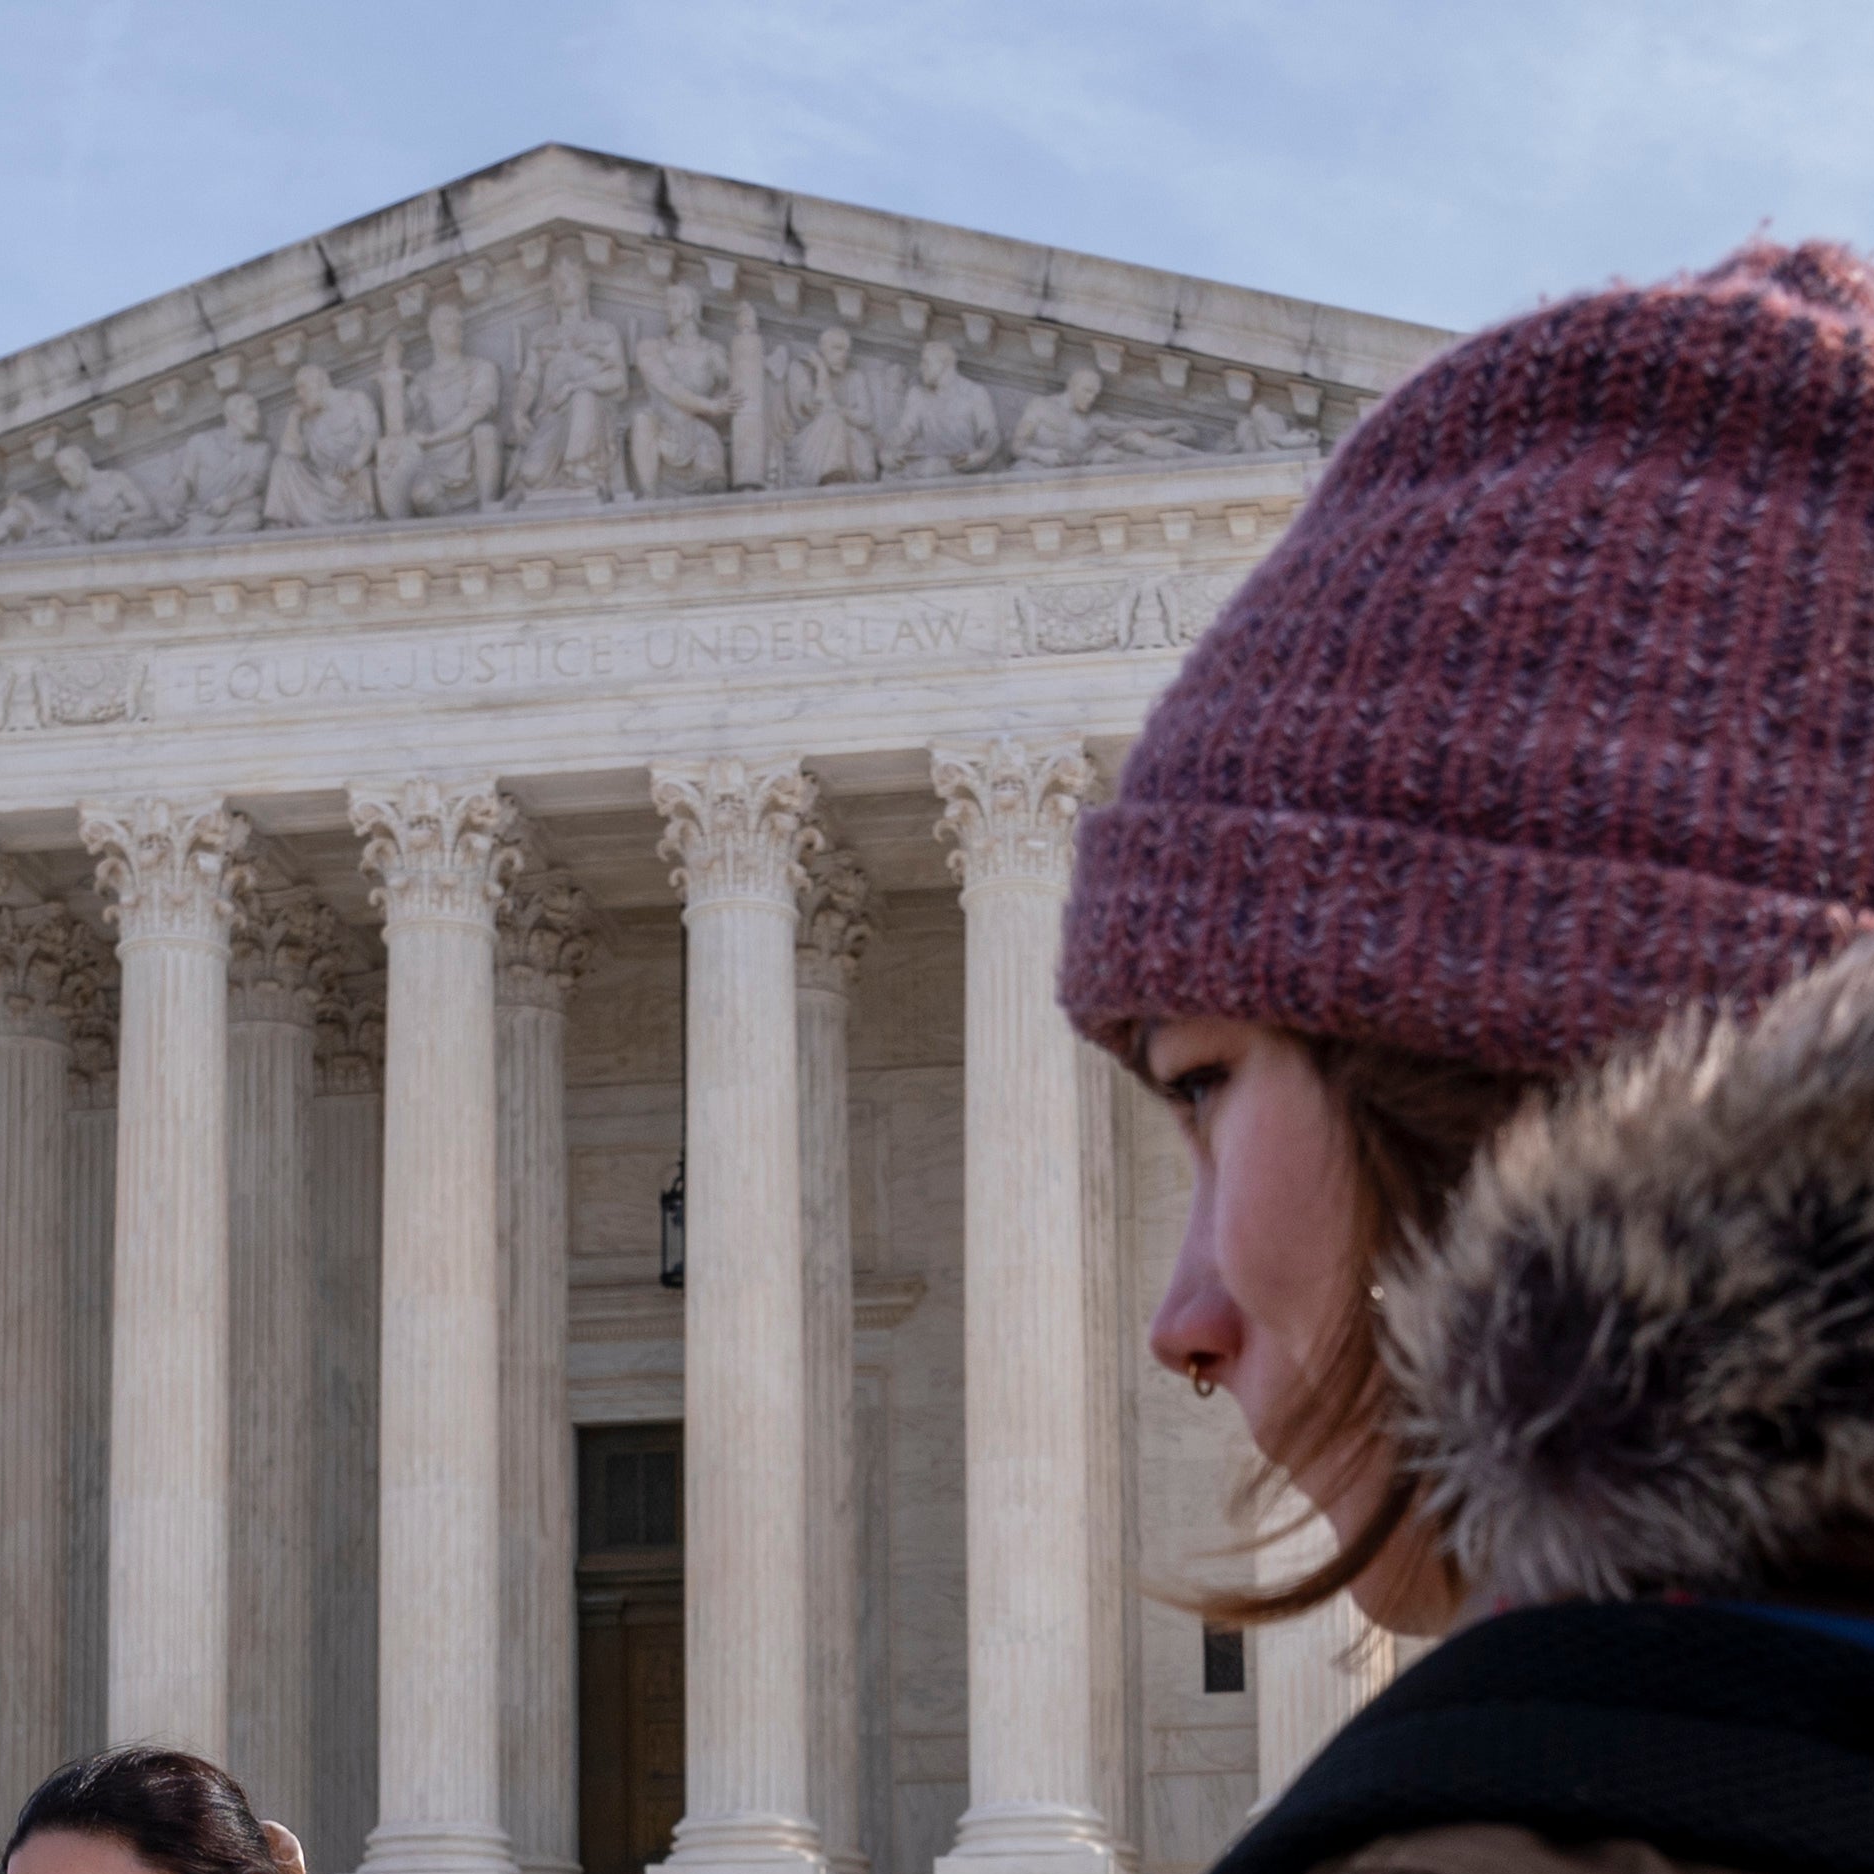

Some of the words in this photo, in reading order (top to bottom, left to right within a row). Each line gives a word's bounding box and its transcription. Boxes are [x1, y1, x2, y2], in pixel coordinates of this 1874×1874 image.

[193, 654, 381, 702] EQUAL
[393, 634, 614, 692] JUSTICE
[643, 618, 828, 671] UNDER
[860, 608, 969, 656] LAW
